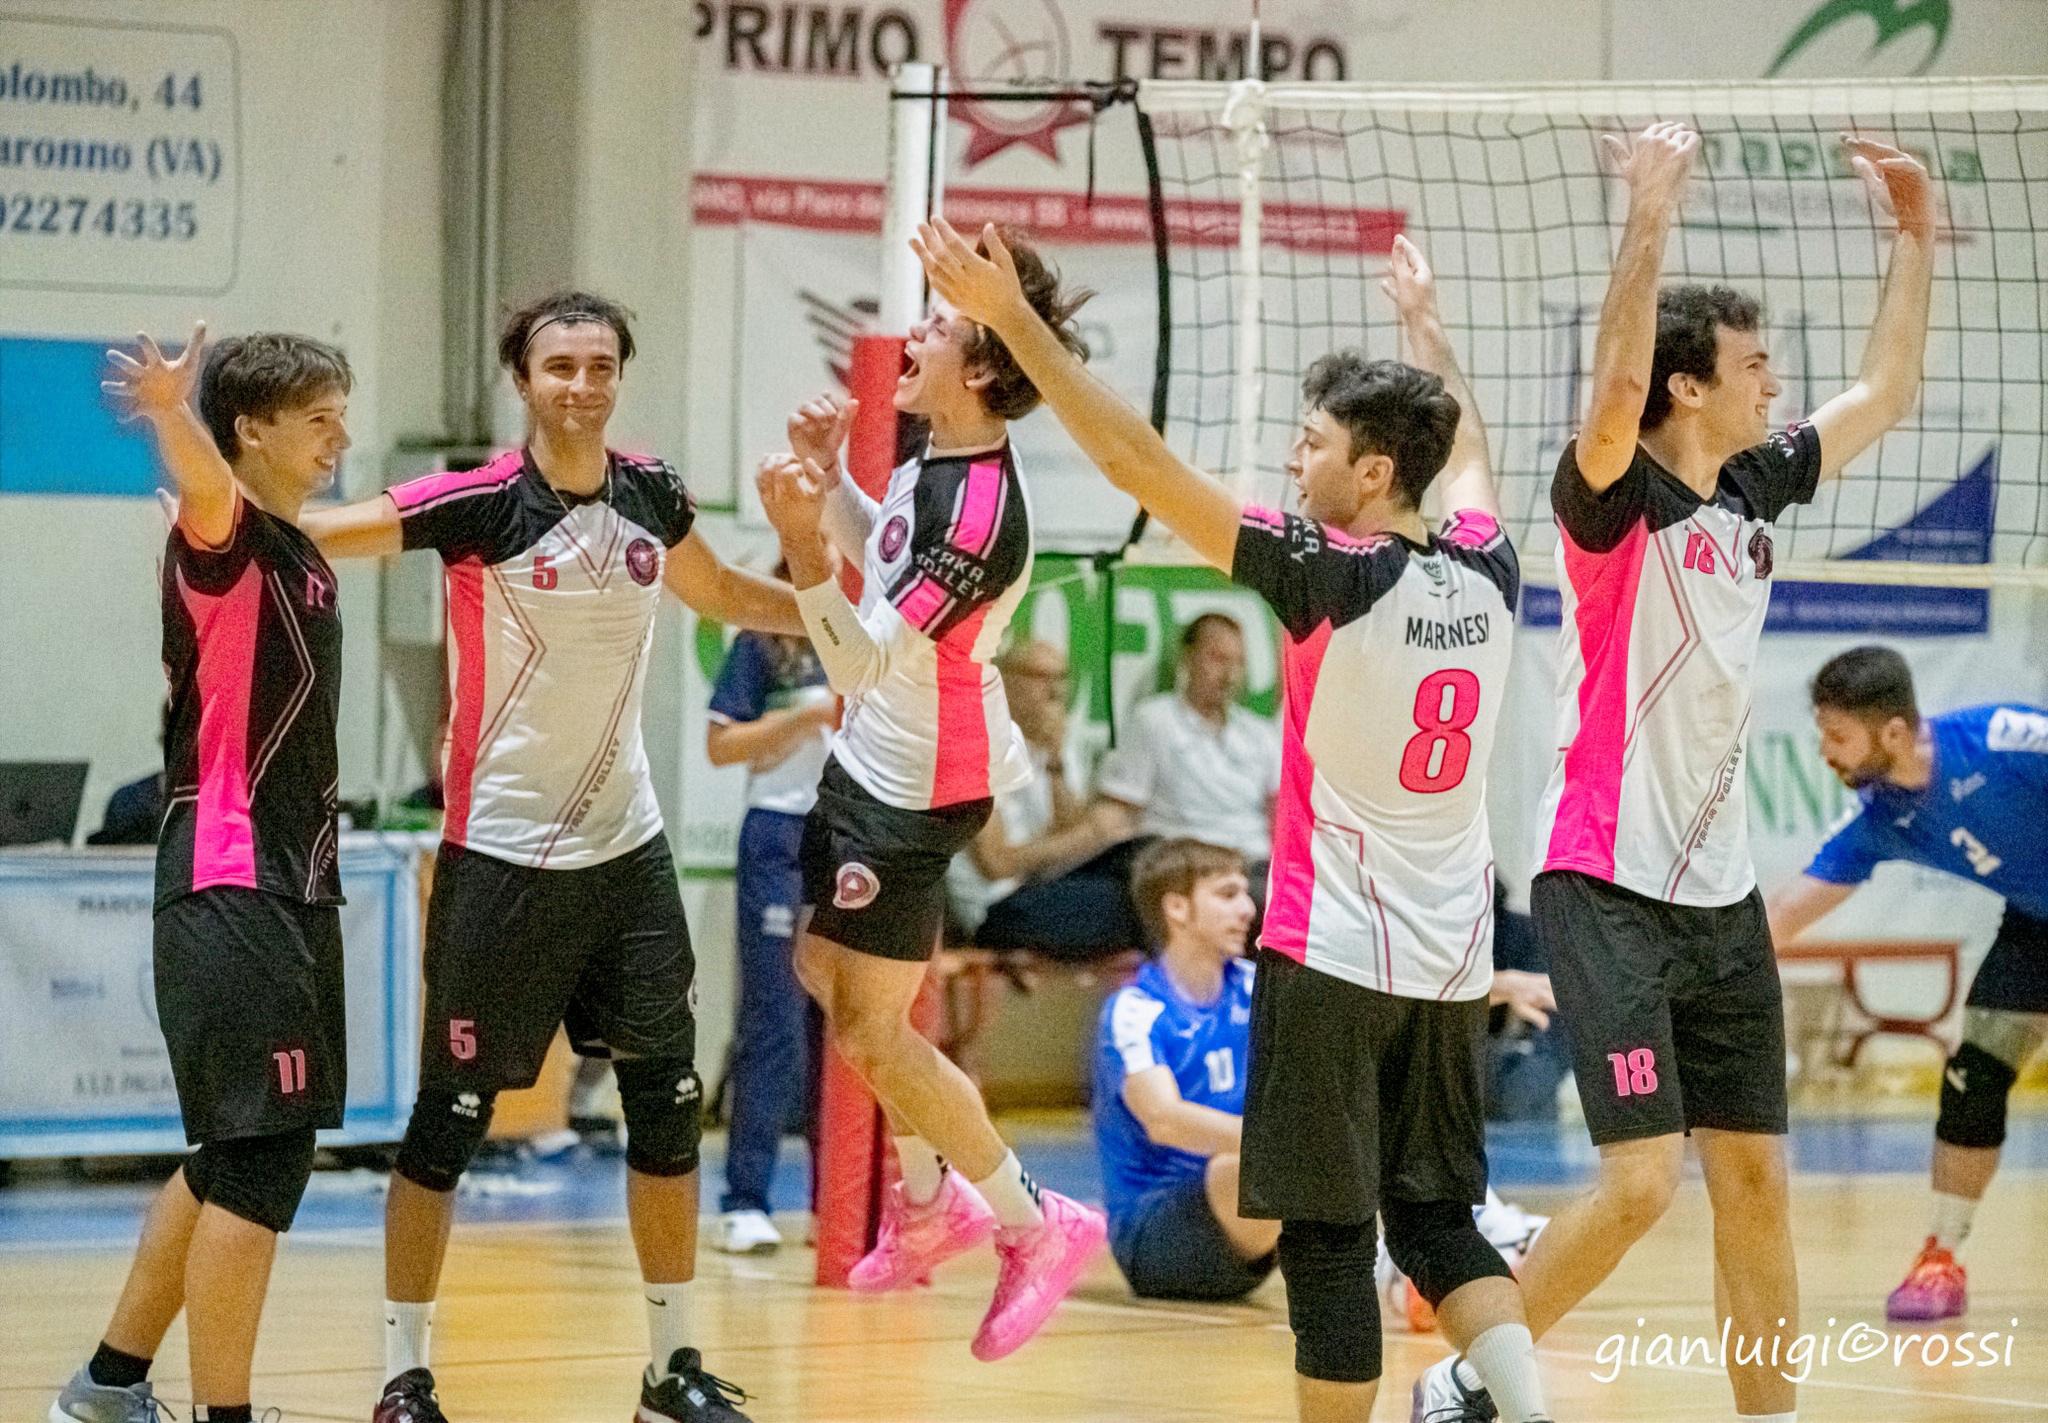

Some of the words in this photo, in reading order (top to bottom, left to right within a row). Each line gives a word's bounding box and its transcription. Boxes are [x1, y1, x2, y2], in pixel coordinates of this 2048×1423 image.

[1096, 27, 1345, 82] TEMPO
[154, 72, 202, 109] 44
[147, 134, 222, 184] (VA)
[532, 556, 558, 590] 5
[928, 546, 984, 582] YAKA
[1683, 532, 1715, 574] 18
[1405, 612, 1490, 650] MARNESI
[1399, 668, 1480, 793] 8
[590, 738, 620, 794] VOLLEY
[1716, 743, 1742, 802] VOLLEY
[449, 1019, 477, 1060] 5
[273, 1049, 306, 1094] 11
[1204, 1046, 1235, 1093] 10
[1607, 1048, 1658, 1097] 18
